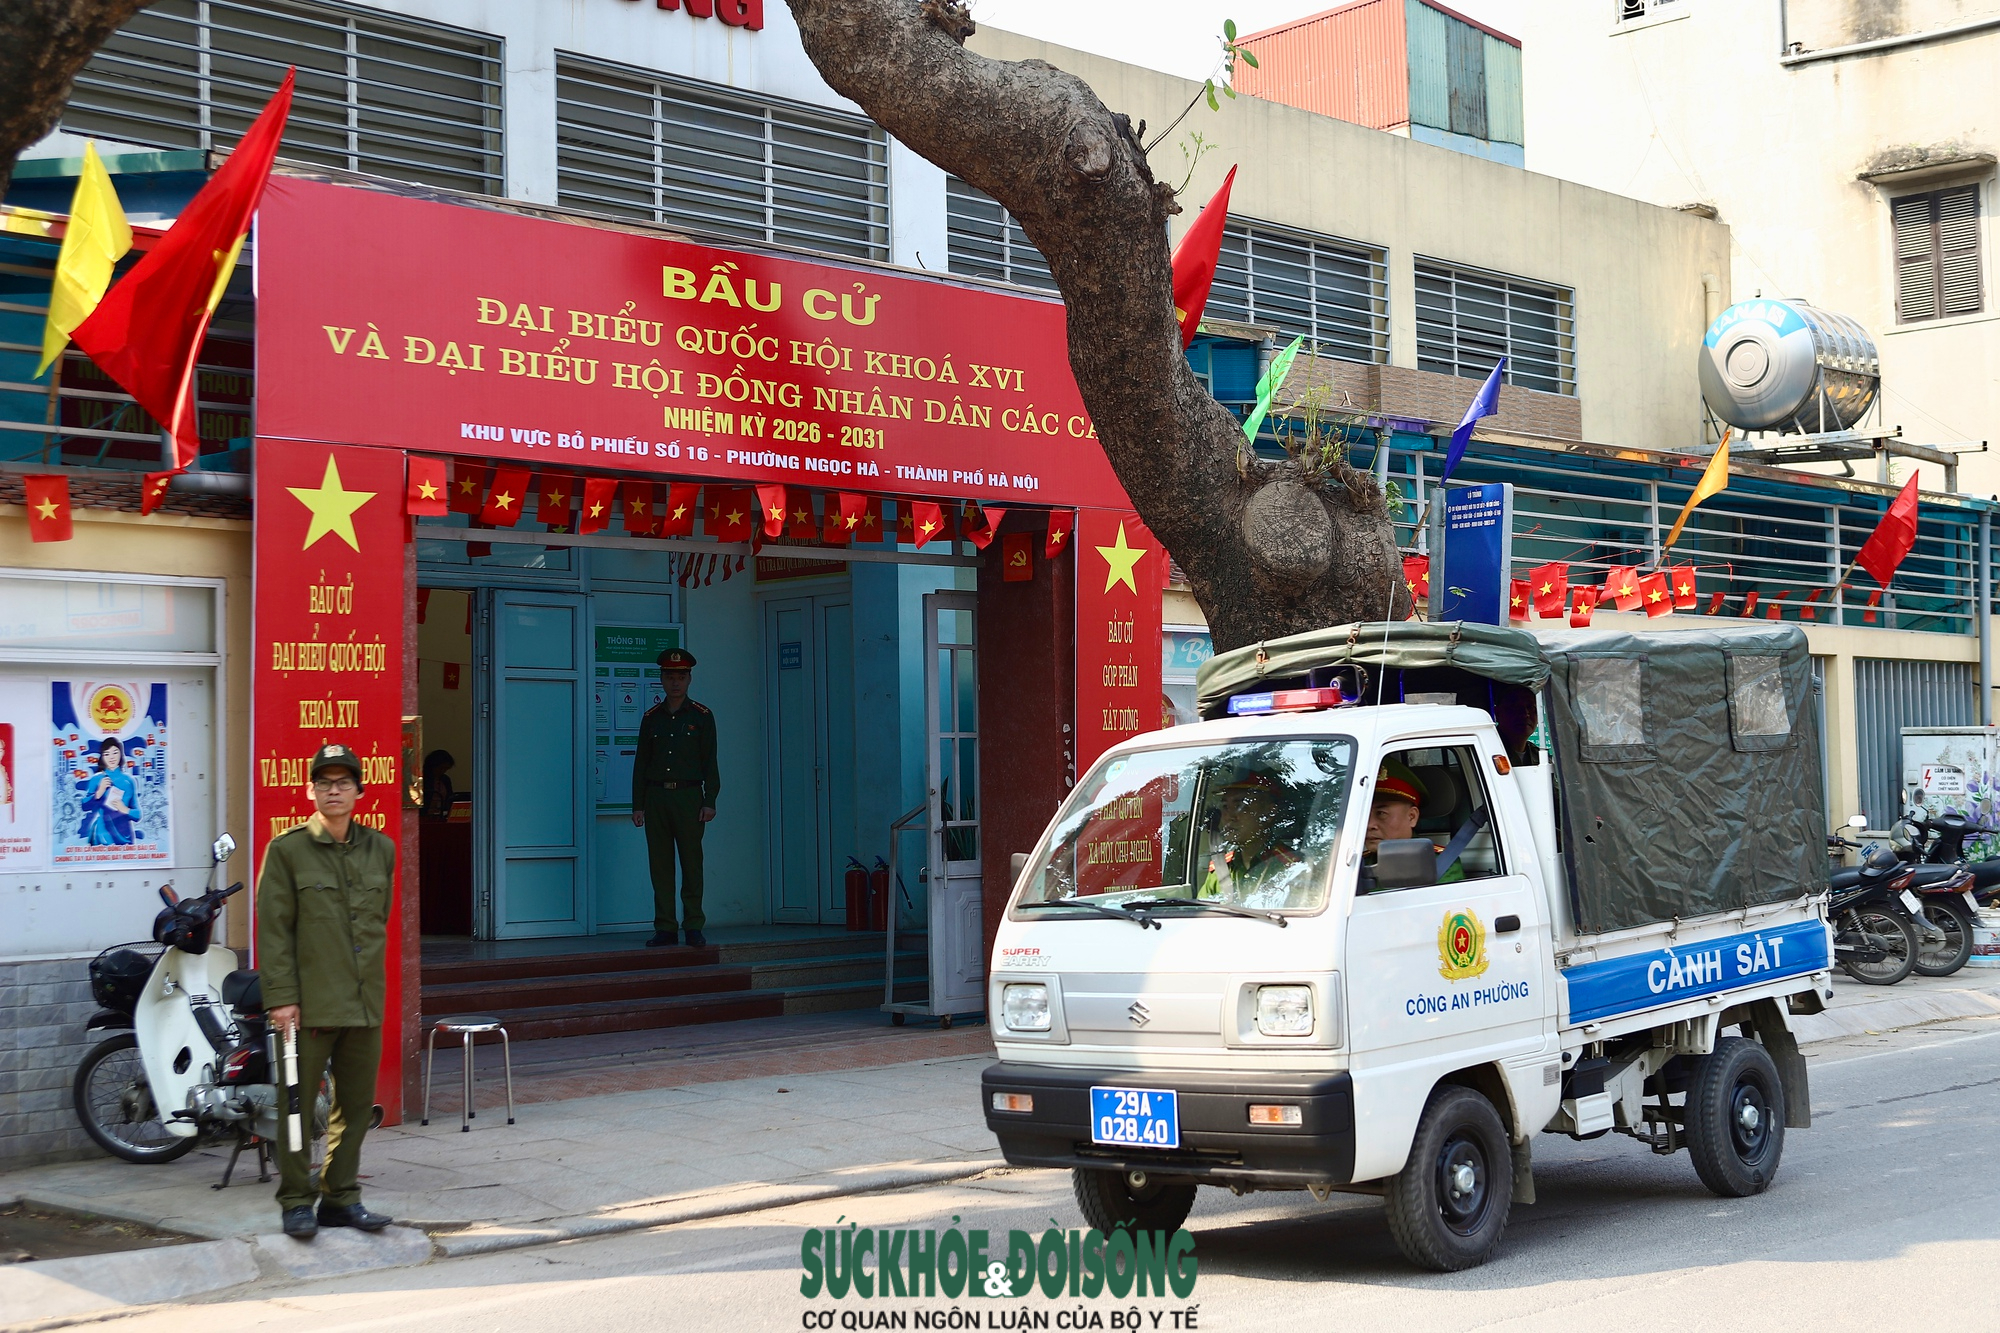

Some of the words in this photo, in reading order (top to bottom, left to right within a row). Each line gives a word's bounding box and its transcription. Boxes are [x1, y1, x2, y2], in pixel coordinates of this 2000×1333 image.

[662, 260, 782, 313] BẦU
[802, 282, 881, 326] CỬ
[476, 297, 555, 336] ĐẠI
[568, 300, 664, 347] BIỂU
[676, 323, 779, 362] QUỐC
[789, 337, 852, 375] HỘI
[864, 353, 959, 385] KHOÁ
[969, 365, 1025, 392] XVI
[322, 322, 390, 360] VÀ
[404, 336, 485, 376] ĐẠI
[499, 338, 599, 385] BIỂU
[612, 359, 684, 399] HỘI
[697, 363, 803, 408] ĐỒNG
[813, 386, 913, 420] NHÂN
[924, 395, 993, 429] DÂN
[1001, 404, 1059, 436] CÁC
[664, 406, 733, 438] NHIỆM
[741, 410, 766, 439] KỲ
[773, 418, 821, 444] 2026
[841, 426, 885, 449] 2031
[460, 423, 504, 441] KHU
[510, 427, 551, 448] VỰC
[557, 430, 584, 450] BỎ
[591, 436, 649, 456] PHIẾU
[655, 440, 680, 459] SỐ
[686, 446, 708, 461] 16
[727, 447, 799, 470] PHƯỜNG
[805, 457, 852, 476] NGỌC
[857, 457, 879, 476] HÀ
[895, 462, 947, 482] THÀNH
[953, 466, 984, 486] PHỐ
[988, 469, 1009, 487] HÀ
[1012, 472, 1039, 491] NỘI
[309, 569, 335, 614] BẦU
[337, 572, 354, 614] CỬ
[607, 635, 633, 645] THÔNG
[635, 637, 646, 646] TIN
[1108, 608, 1122, 643] BẦU
[1124, 611, 1134, 643] CỬ
[272, 642, 295, 678] ĐẠI
[298, 622, 327, 671] BIỂU
[329, 629, 362, 673] QUỐC
[364, 634, 386, 679] HỘI
[1103, 658, 1117, 687] GÓP
[1119, 653, 1138, 687] PHẦN
[299, 691, 334, 728] KHOÁ
[336, 700, 359, 728] XVI
[1103, 702, 1118, 731] XÂY
[1119, 706, 1139, 736] DỰNG
[261, 749, 279, 787] VÀ
[281, 758, 303, 794] ĐẠI
[362, 741, 395, 785] ĐỒNG
[1100, 834, 1113, 871] HỘI
[1115, 830, 1128, 862] CHỦ
[1000, 955, 1052, 967] CARRY
[1002, 948, 1040, 956] SUPER
[1406, 993, 1447, 1016] CÔNG
[1451, 992, 1470, 1010] AN
[1474, 980, 1529, 1006] PHƯỜNG
[1114, 1091, 1152, 1117] 29A
[1100, 1116, 1168, 1144] 028.40
